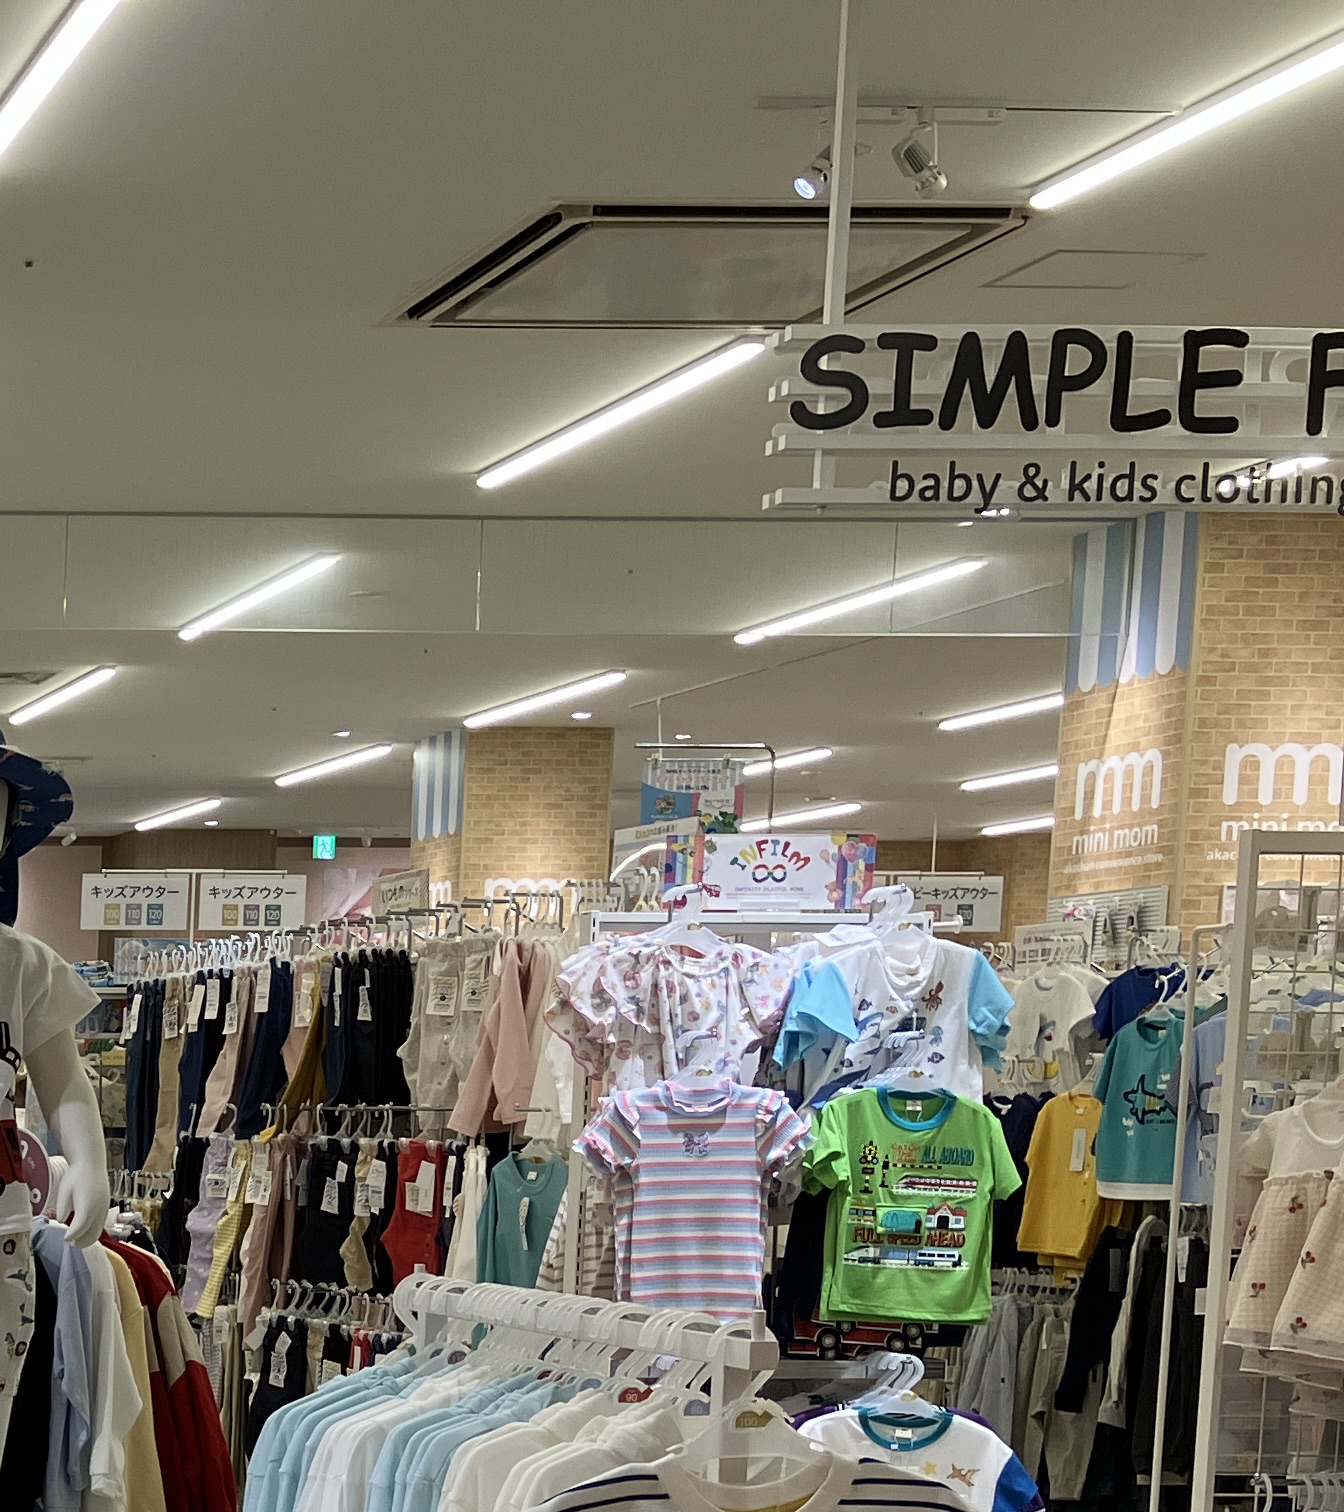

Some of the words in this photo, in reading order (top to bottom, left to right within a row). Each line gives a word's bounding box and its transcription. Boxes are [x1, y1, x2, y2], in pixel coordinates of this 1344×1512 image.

[789, 327, 1250, 434] SIMPLE
[889, 460, 1002, 515] baby
[1017, 462, 1050, 503] &
[1068, 460, 1159, 504] kids
[1072, 823, 1109, 855] mini
[1113, 824, 1158, 850] mom
[729, 838, 811, 872] INFILM
[90, 884, 180, 899] キッズアウター
[208, 884, 297, 900] キッズアウター
[912, 886, 999, 900] ビーキッズアウター
[105, 909, 120, 919] 100
[127, 909, 140, 919] 110
[148, 909, 163, 919] 120
[223, 909, 238, 920] 100
[245, 909, 258, 919] 110
[266, 909, 280, 920] 120
[920, 1144, 937, 1164] ALL
[853, 1227, 884, 1244] FULL
[925, 1230, 967, 1248] AHEAD
[625, 1393, 638, 1402] 90
[739, 1417, 758, 1427] 100
